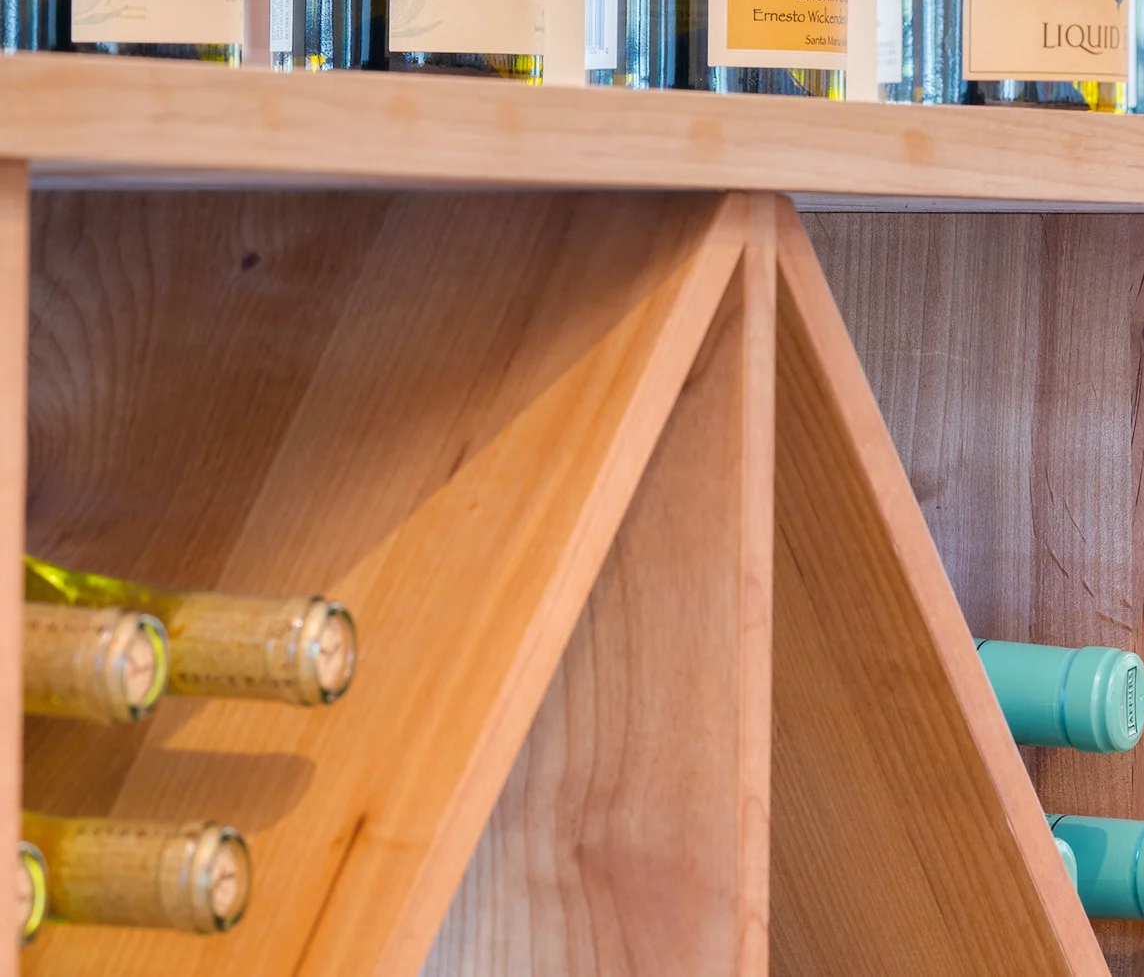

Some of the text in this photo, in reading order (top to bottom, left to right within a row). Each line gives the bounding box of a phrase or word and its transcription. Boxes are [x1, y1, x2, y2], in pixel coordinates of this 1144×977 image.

[753, 7, 806, 23] Ernesto
[804, 34, 827, 46] Santa
[1043, 21, 1120, 56] LIQUID
